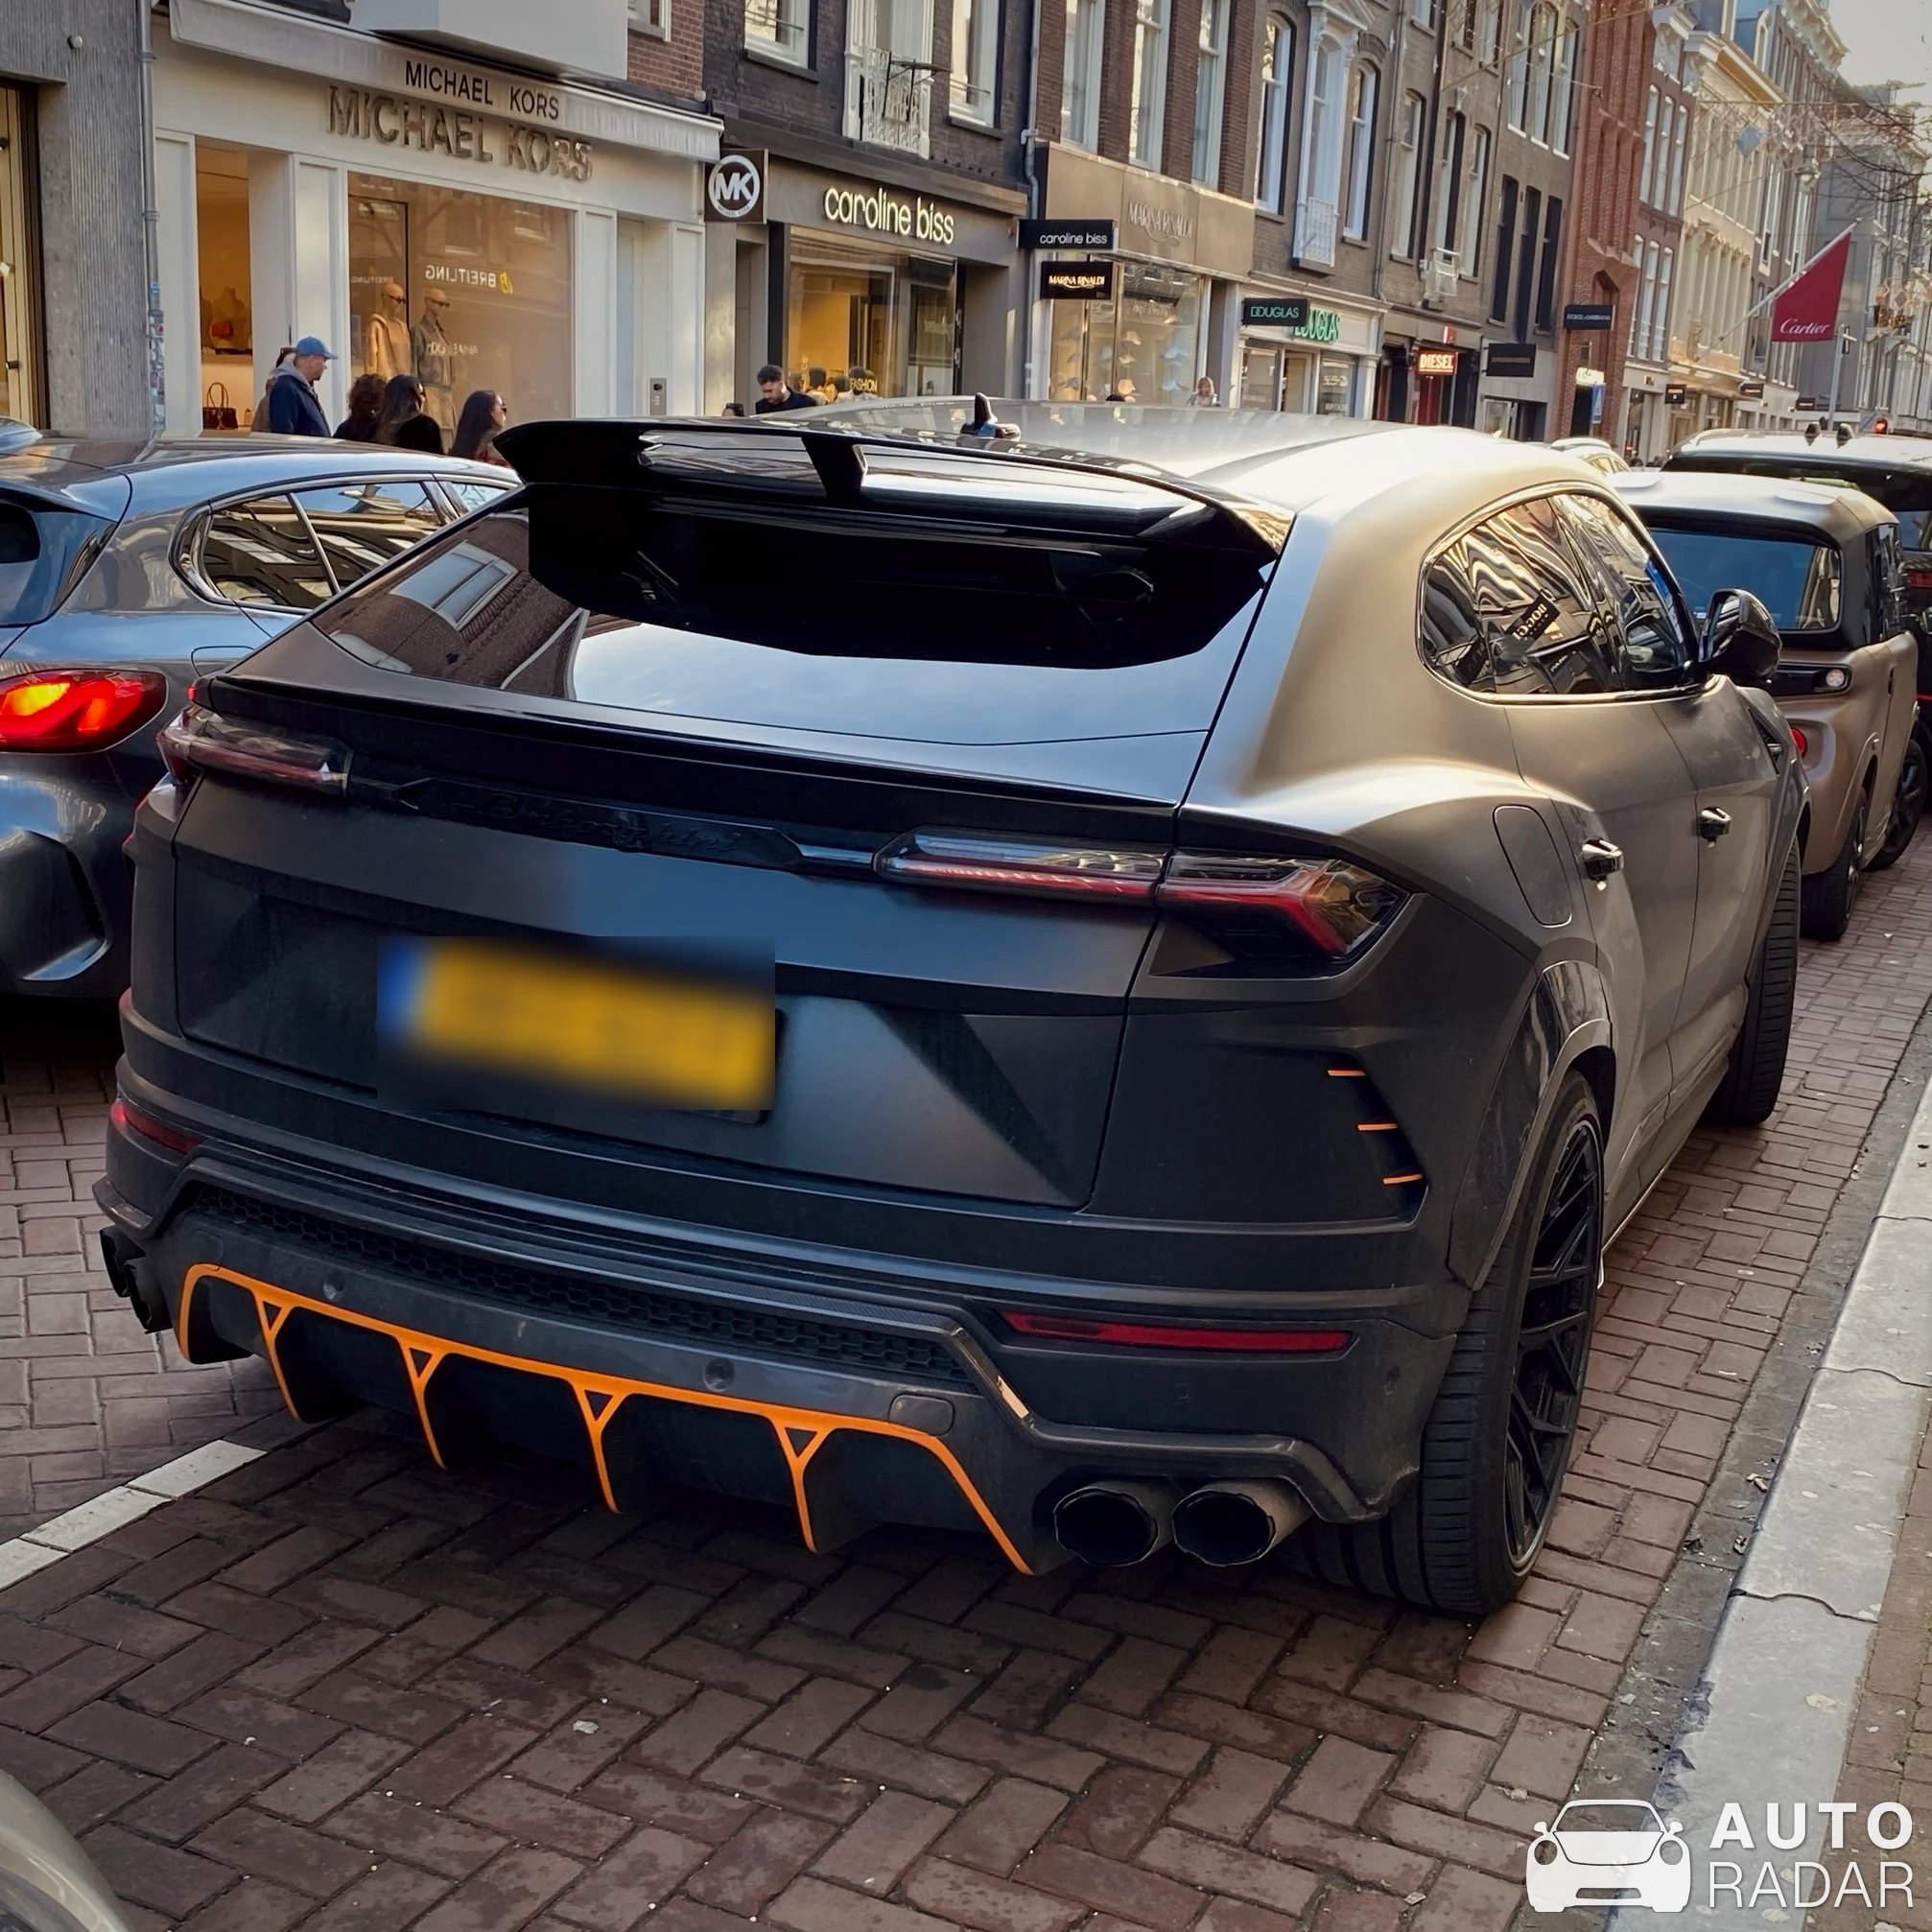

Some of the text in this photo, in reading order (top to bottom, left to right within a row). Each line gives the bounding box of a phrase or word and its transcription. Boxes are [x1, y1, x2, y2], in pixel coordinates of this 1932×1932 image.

[405, 60, 559, 120] MICHAEL KORS
[326, 84, 593, 182] MICHAEL KORS
[715, 173, 753, 200] MK
[825, 187, 954, 245] caroline biss
[1039, 232, 1108, 245] caroline biss
[1048, 275, 1105, 287] MARINA RINALDI
[1250, 306, 1300, 318] DOUGLAS
[1779, 318, 1829, 335] Cartier
[1420, 353, 1454, 369] DIESEL
[850, 378, 878, 392] FASHION
